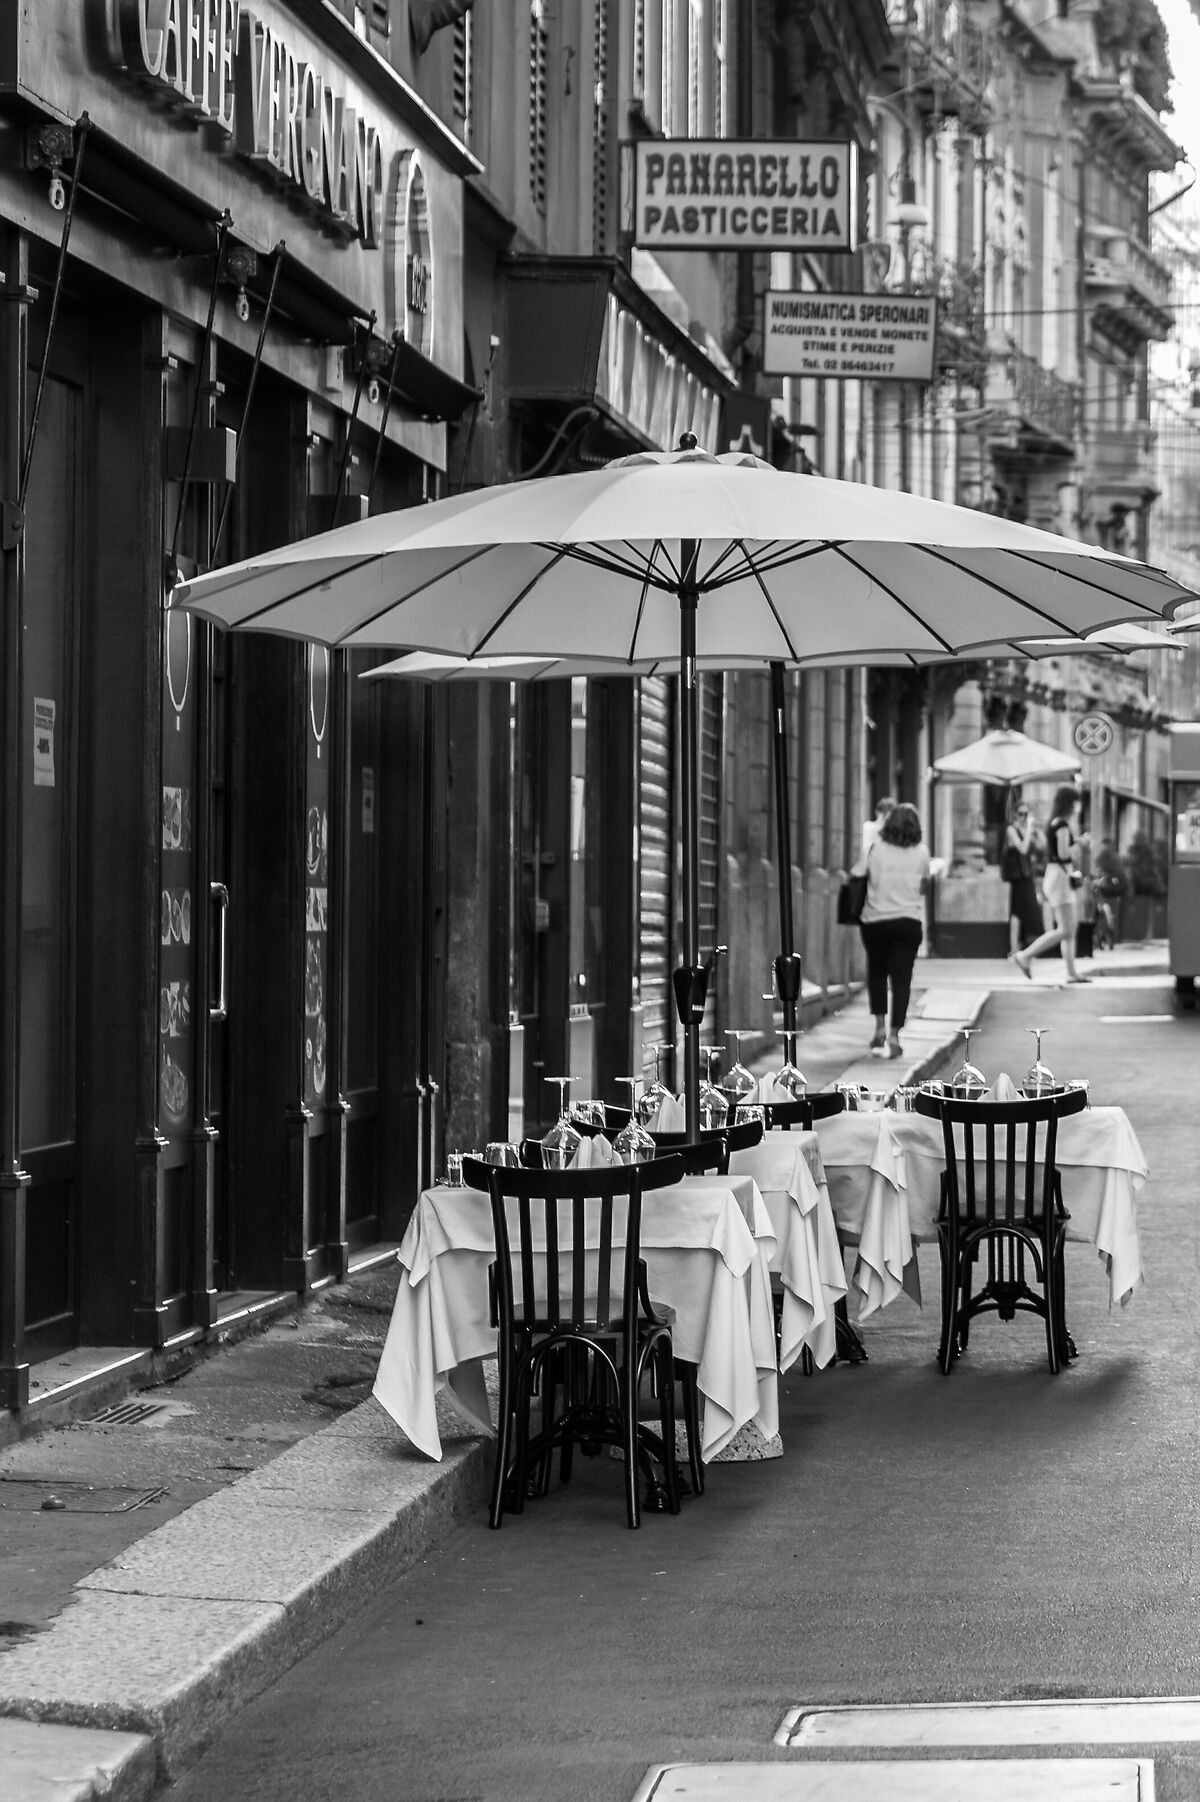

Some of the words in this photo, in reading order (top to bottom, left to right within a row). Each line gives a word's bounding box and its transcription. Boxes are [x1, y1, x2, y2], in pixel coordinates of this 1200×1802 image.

[250, 18, 384, 250] VERGNANO
[645, 152, 840, 199] PANARELLO
[643, 205, 841, 236] PASTICCERIA
[771, 300, 855, 322] NUMISMATICA
[859, 304, 930, 325] SPERONARI
[770, 324, 826, 337] ACQUISTA
[830, 326, 837, 337] E
[840, 327, 878, 340] VENDE
[881, 328, 929, 342] MONETE
[802, 340, 837, 352] STIME
[840, 342, 847, 353] E
[851, 343, 896, 355] PERIZIE
[801, 358, 820, 370] Tel.
[824, 359, 837, 370] 02
